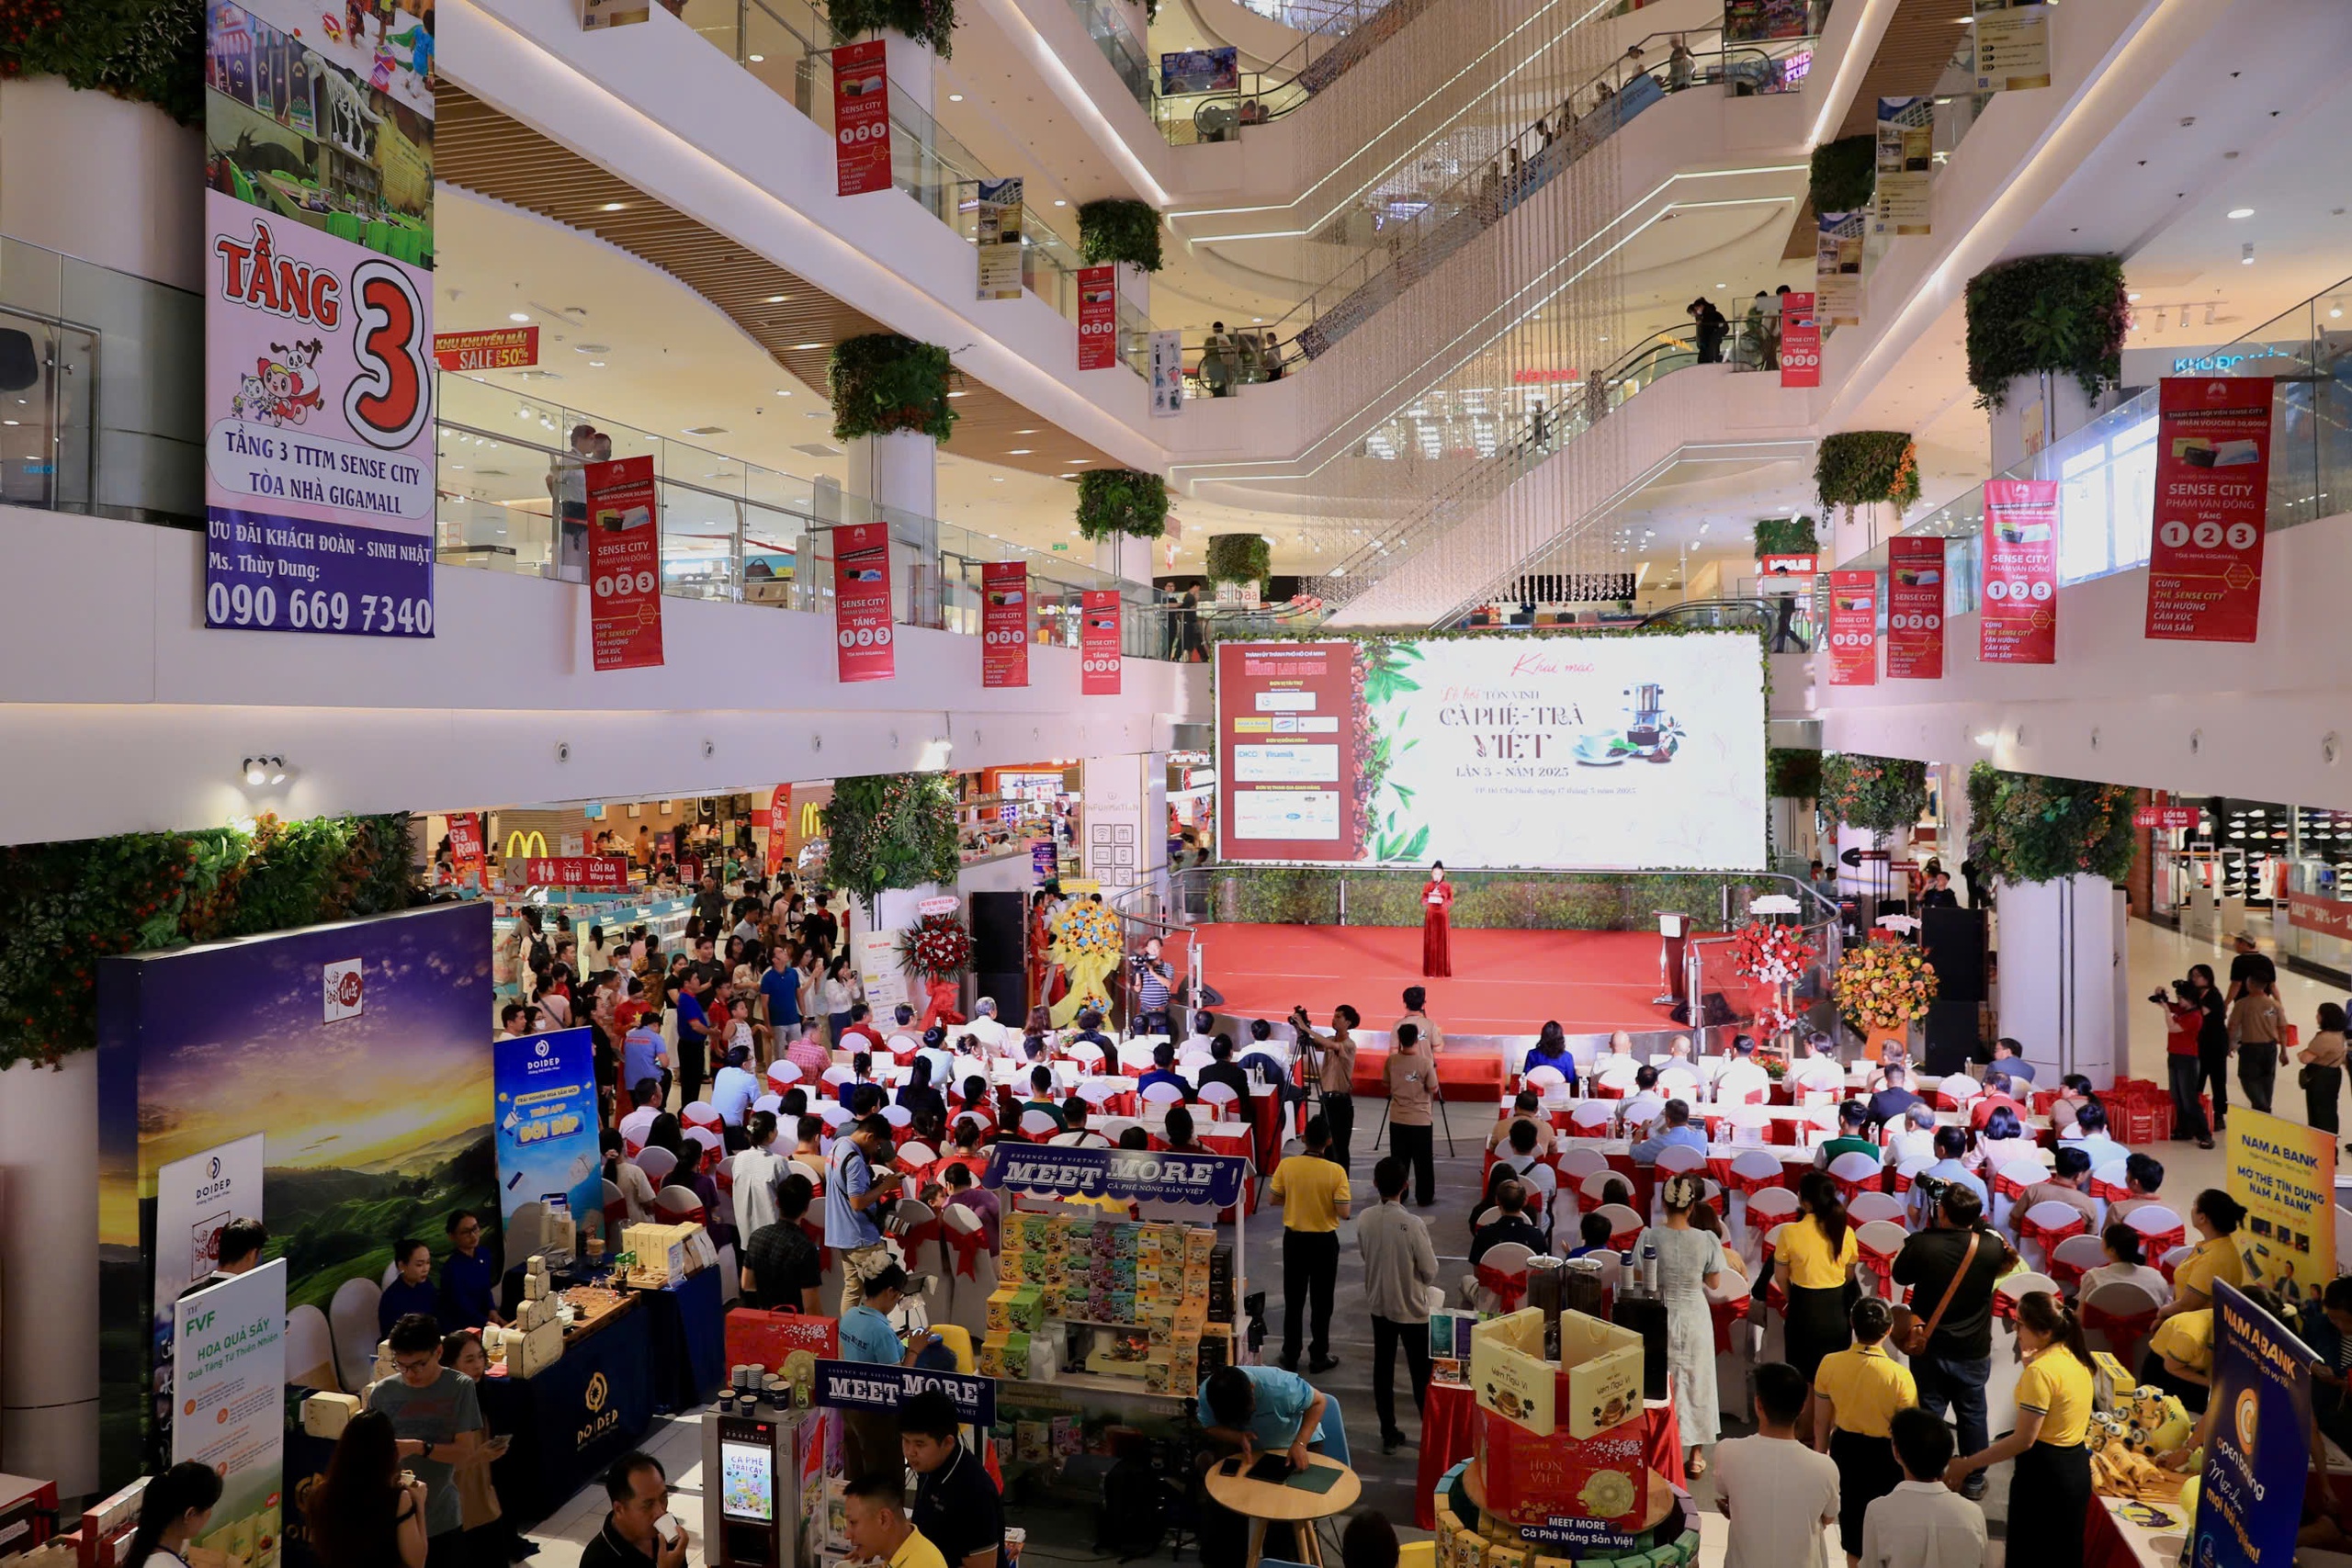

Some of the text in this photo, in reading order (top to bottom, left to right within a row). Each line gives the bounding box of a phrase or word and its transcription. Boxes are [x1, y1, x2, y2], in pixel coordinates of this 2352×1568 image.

[841, 101, 882, 115] SENSE CITY
[215, 221, 425, 444] TẦNG 3
[435, 329, 528, 350] KHU KHUYẾN MÃI
[459, 347, 528, 369] SALE 50%
[225, 423, 420, 486] TẦNG 3 TTTM SENSE CITY
[249, 468, 402, 514] TÒA NHÀ GIGAMALL
[2169, 483, 2254, 497] SENSE CITY
[209, 520, 432, 566] ƯU ĐÃI KHÁCH ĐOÀN SINH NHẬT
[597, 541, 650, 557] SENSE CITY
[209, 551, 320, 581] Ms. Thùy Dung:
[1992, 554, 2049, 564] SENSE CITY
[2156, 579, 2181, 588] CÙNG
[841, 597, 886, 609] SENSE CITY
[1894, 593, 1918, 602] SENSE
[2176, 591, 2201, 600] SENSE
[2203, 592, 2224, 601] CITY
[208, 581, 433, 635] 090 669 7340
[852, 616, 877, 626] TẦNG
[2152, 623, 2174, 631] MUA
[1510, 652, 1558, 677] Khai
[1512, 690, 1540, 700] VINH
[1439, 703, 1470, 726] CÀ
[1472, 728, 1553, 763] VIỆT
[1484, 767, 1492, 777] 3
[1538, 767, 1569, 777] 2025
[2176, 810, 2188, 818] RA
[589, 861, 616, 873] LỐI RA
[589, 873, 604, 882] Way
[526, 1057, 560, 1070] DOIDEP
[520, 1120, 548, 1143] ĐÔI
[1011, 1153, 1049, 1161] ESSENCE
[1067, 1156, 1106, 1165] VIETNAM
[2242, 1134, 2269, 1154] NAM
[2271, 1145, 2281, 1156] A
[2282, 1147, 2319, 1170] BANK
[1002, 1157, 1214, 1190] MEET MORE
[2237, 1165, 2254, 1179] MỞ
[2255, 1170, 2273, 1188] THẺ
[196, 1178, 232, 1200] DOIDEP
[1106, 1180, 1205, 1196] CÀ PHÊ NÔNG SẢN VIỆT
[2249, 1182, 2271, 1200] NAM
[2284, 1195, 2312, 1214] BANK
[186, 1310, 216, 1337] FVF
[198, 1316, 270, 1361] HOA QUẢ SẤY
[2223, 1303, 2251, 1340] NAM
[2251, 1328, 2260, 1348] A
[2260, 1336, 2296, 1380] BANK
[828, 1376, 899, 1406] MEET
[902, 1373, 980, 1405] MORE
[2206, 1486, 2224, 1513] mọi
[1548, 1517, 1606, 1530] MEET MORE
[1521, 1526, 1634, 1547] Cà Phê Nông Sản Việt
